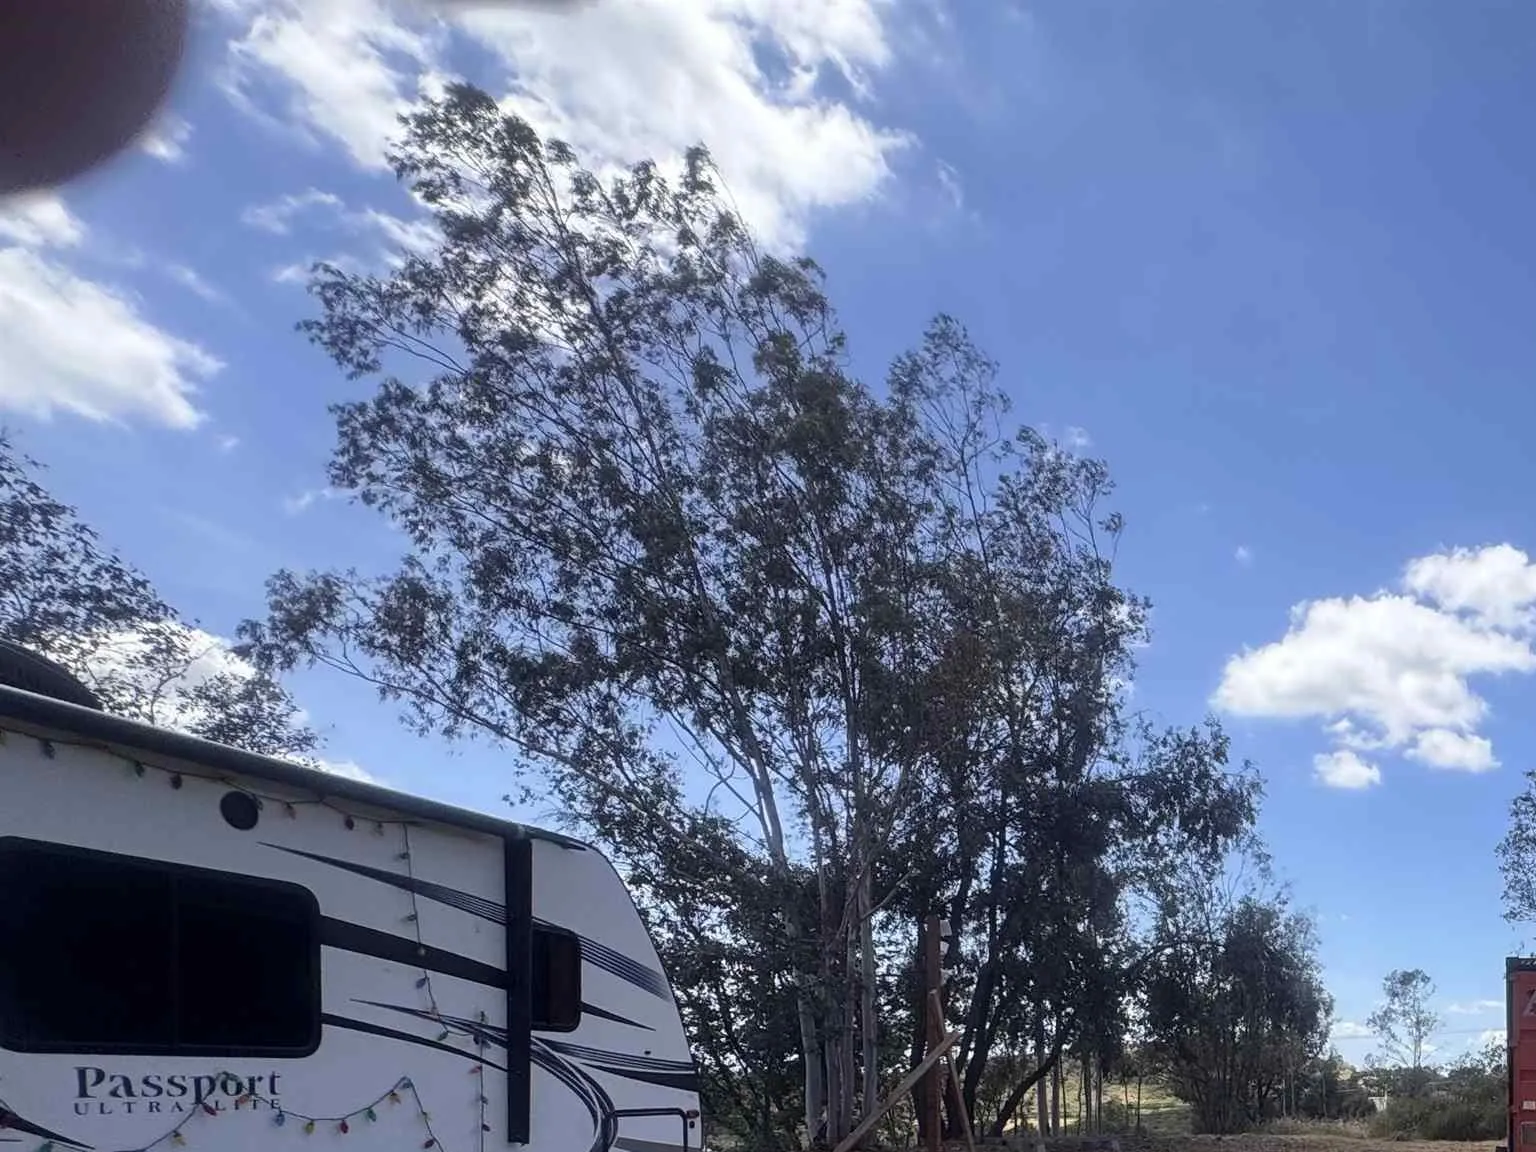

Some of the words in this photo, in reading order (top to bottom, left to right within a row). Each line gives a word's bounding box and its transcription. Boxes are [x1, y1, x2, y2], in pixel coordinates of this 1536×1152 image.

[74, 1066, 282, 1105] Passport
[74, 1100, 184, 1116] ULTRA
[215, 1099, 280, 1111] LITE
